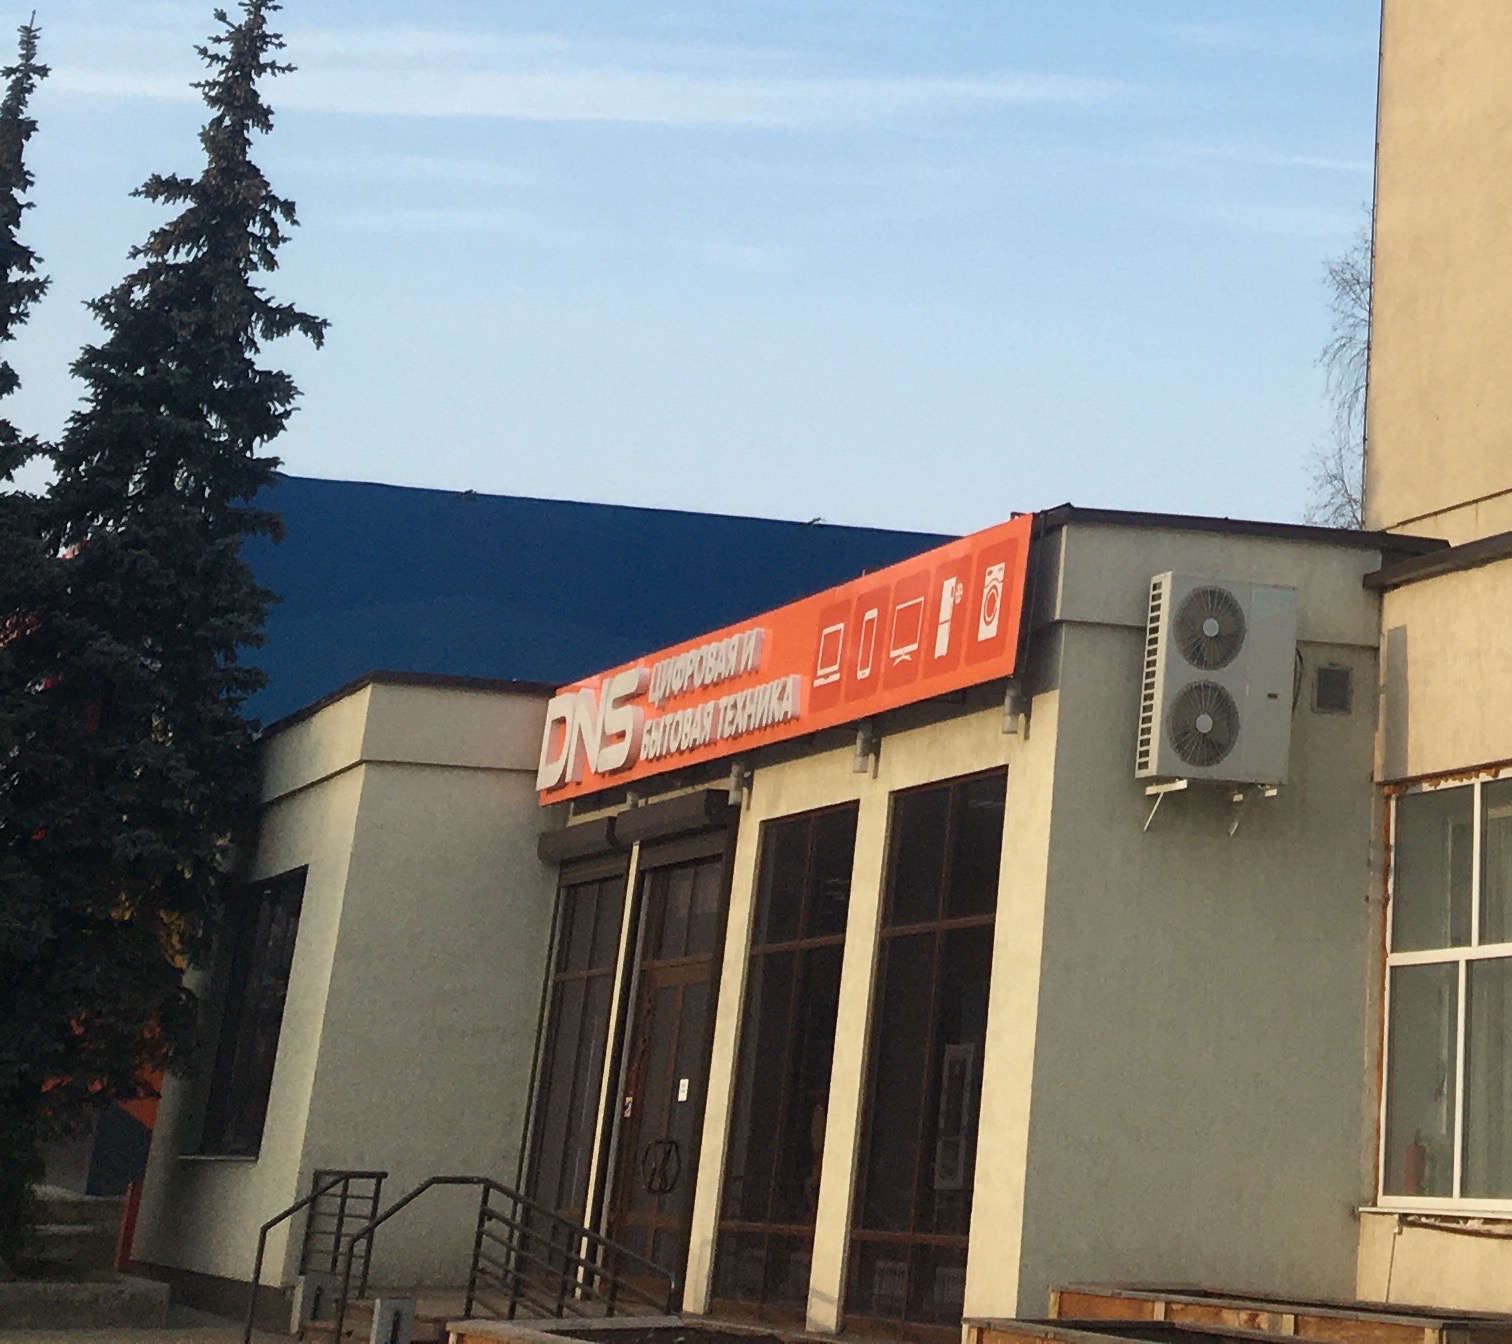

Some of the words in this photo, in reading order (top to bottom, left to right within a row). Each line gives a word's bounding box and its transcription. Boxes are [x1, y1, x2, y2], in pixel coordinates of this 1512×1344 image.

[648, 633, 743, 704] ЦИФРОВАЯ
[741, 627, 766, 671] И
[536, 665, 650, 792] DNS
[640, 699, 714, 761] БЫТОВАЯ
[716, 674, 801, 739] ТЕХНИКА
